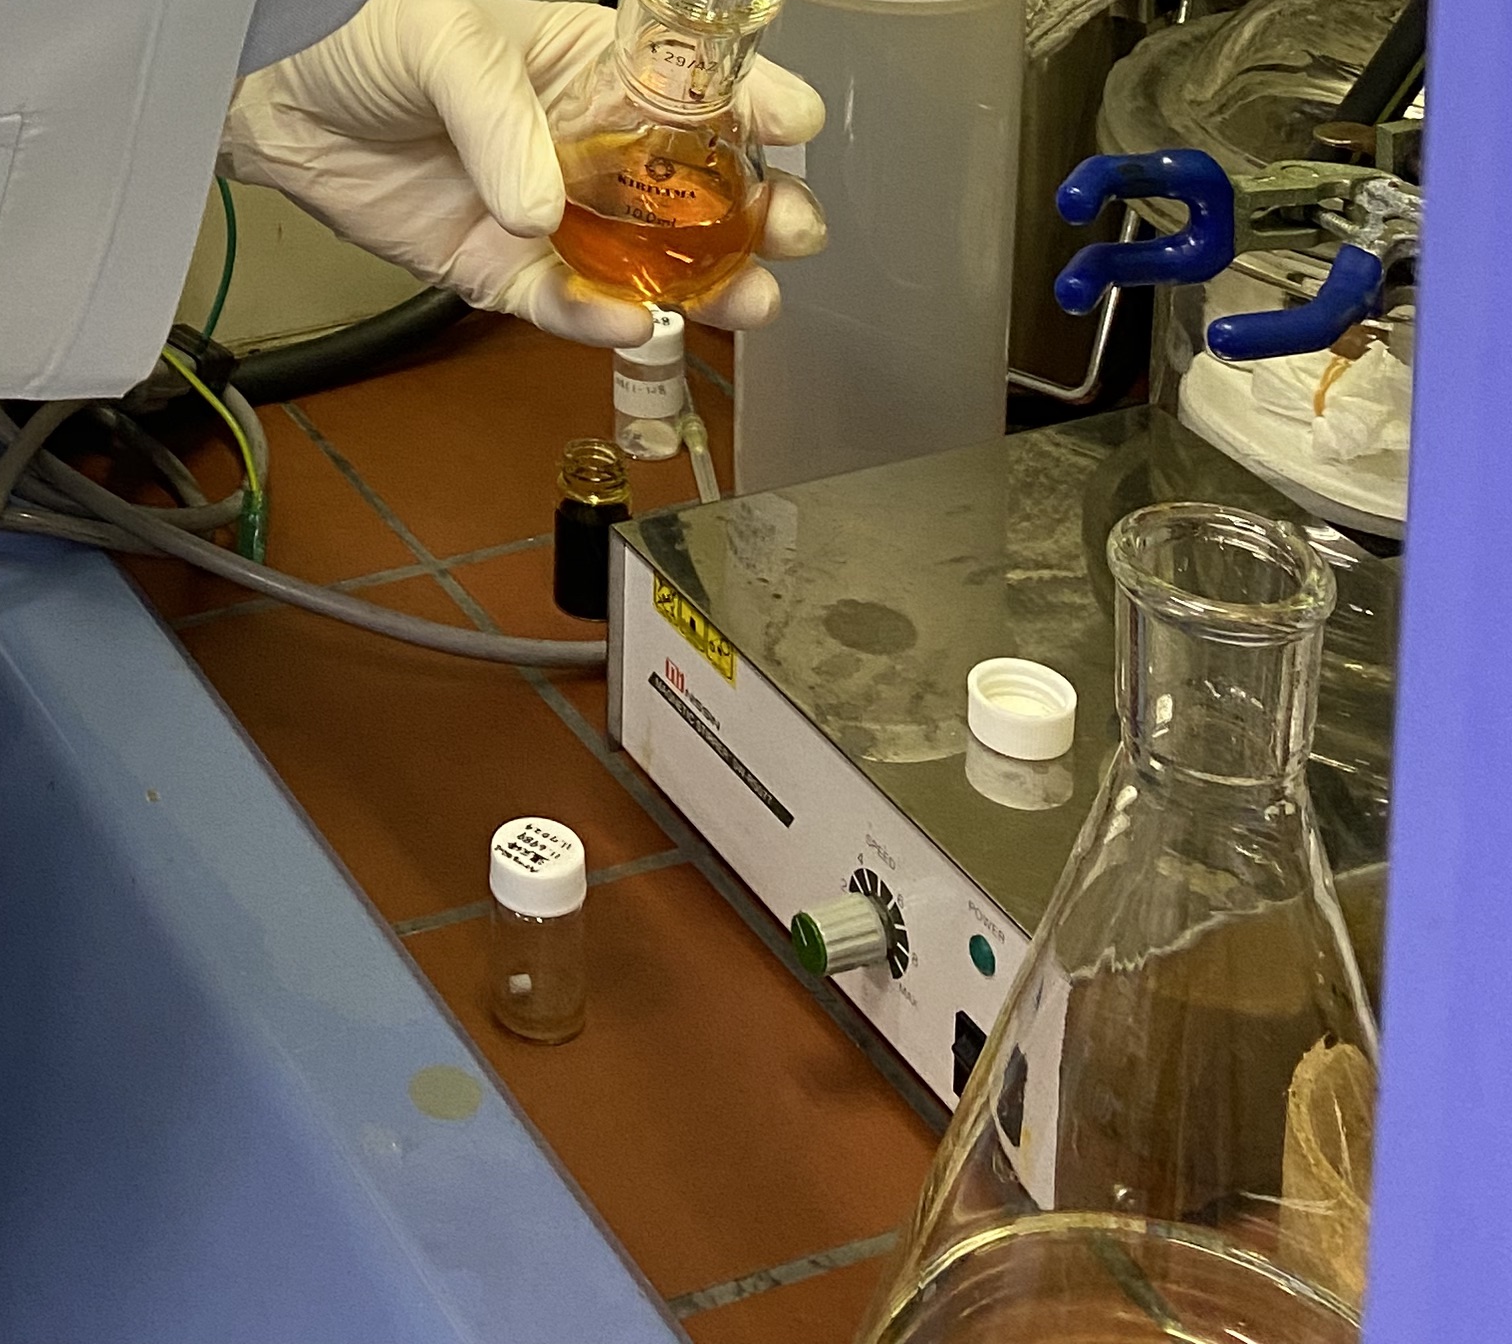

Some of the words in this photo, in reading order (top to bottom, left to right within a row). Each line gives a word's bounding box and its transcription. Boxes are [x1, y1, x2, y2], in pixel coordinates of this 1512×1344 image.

[664, 51, 719, 73] 29/42
[857, 852, 864, 865] 4
[865, 833, 896, 871] SPEED
[840, 877, 848, 893] 2
[897, 893, 905, 909] 6
[968, 899, 1006, 944] POWER
